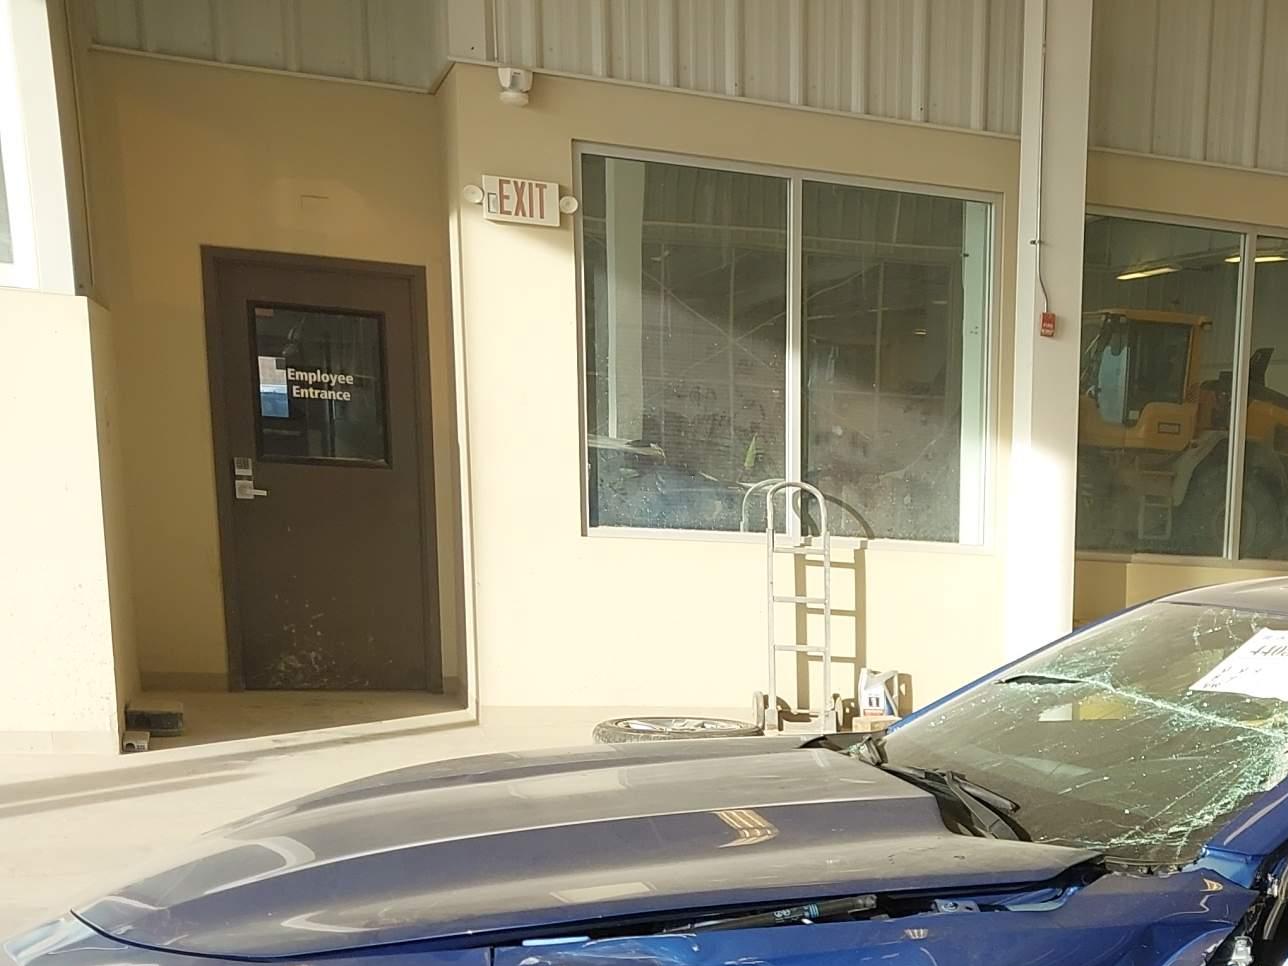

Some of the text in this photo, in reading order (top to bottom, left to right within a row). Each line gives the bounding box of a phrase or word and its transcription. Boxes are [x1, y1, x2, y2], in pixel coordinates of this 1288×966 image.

[499, 179, 547, 219] EXIT
[287, 368, 354, 385] Employee
[292, 385, 351, 401] Entrance
